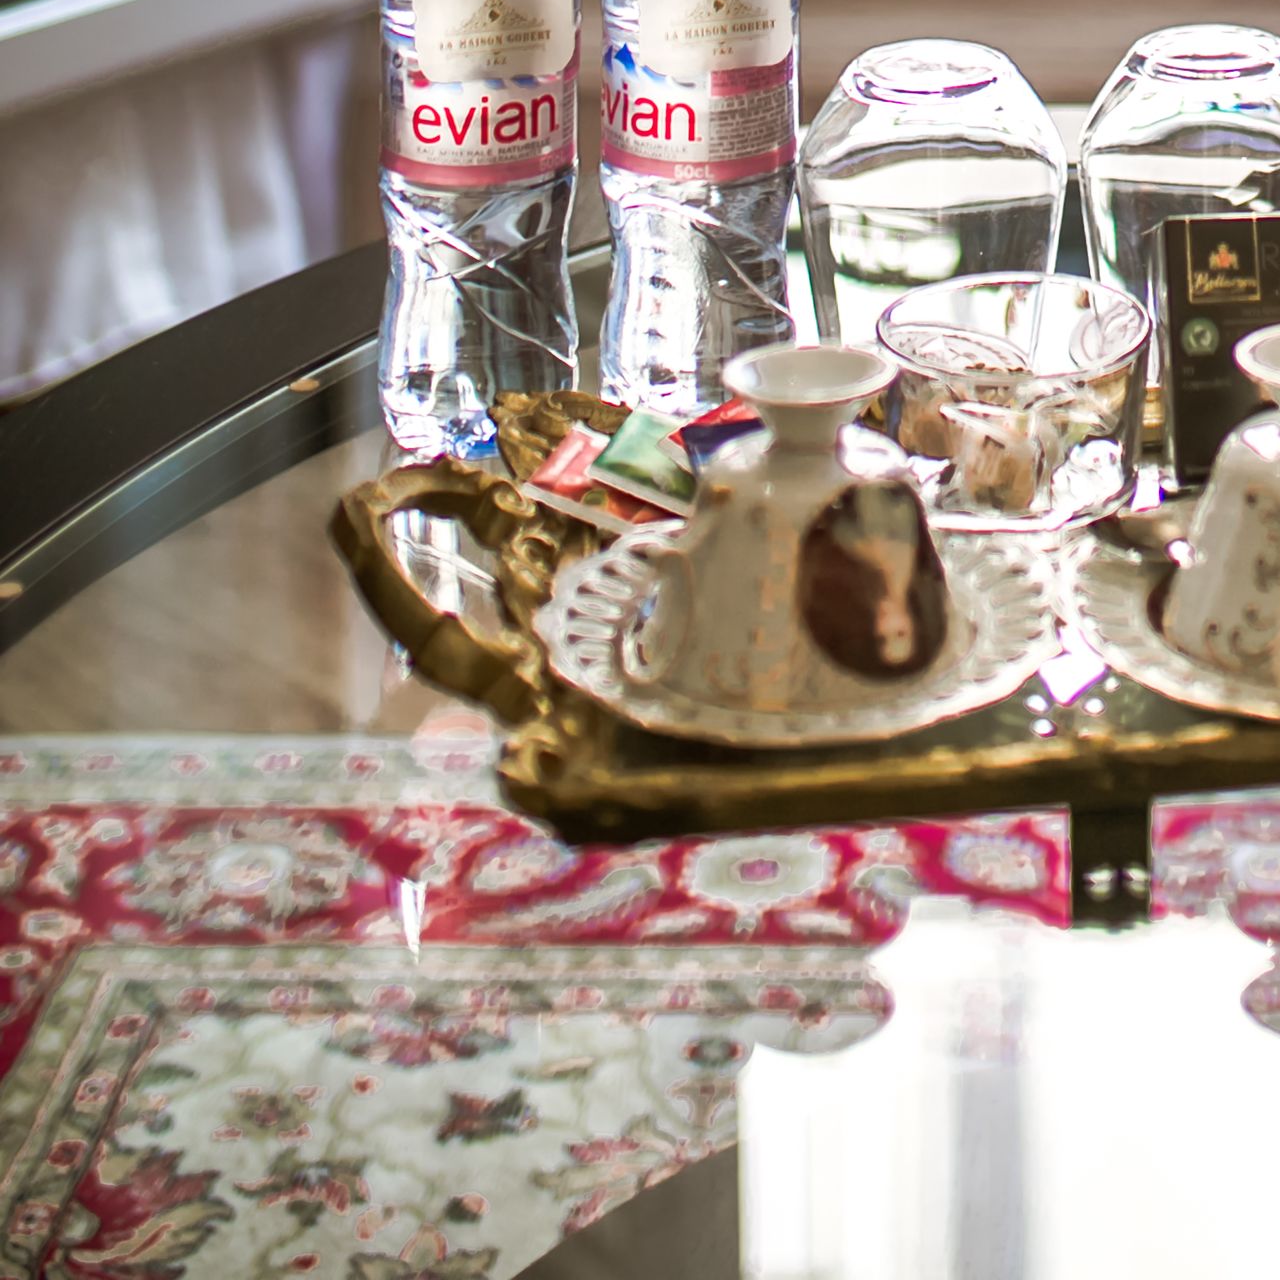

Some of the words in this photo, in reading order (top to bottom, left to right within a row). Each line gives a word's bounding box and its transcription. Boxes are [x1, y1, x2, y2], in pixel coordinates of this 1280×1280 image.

[459, 34, 502, 49] MAISON
[507, 29, 552, 44] GOBERT
[684, 24, 728, 39] MAISON
[732, 19, 776, 33] GOBERT
[412, 93, 558, 146] evian
